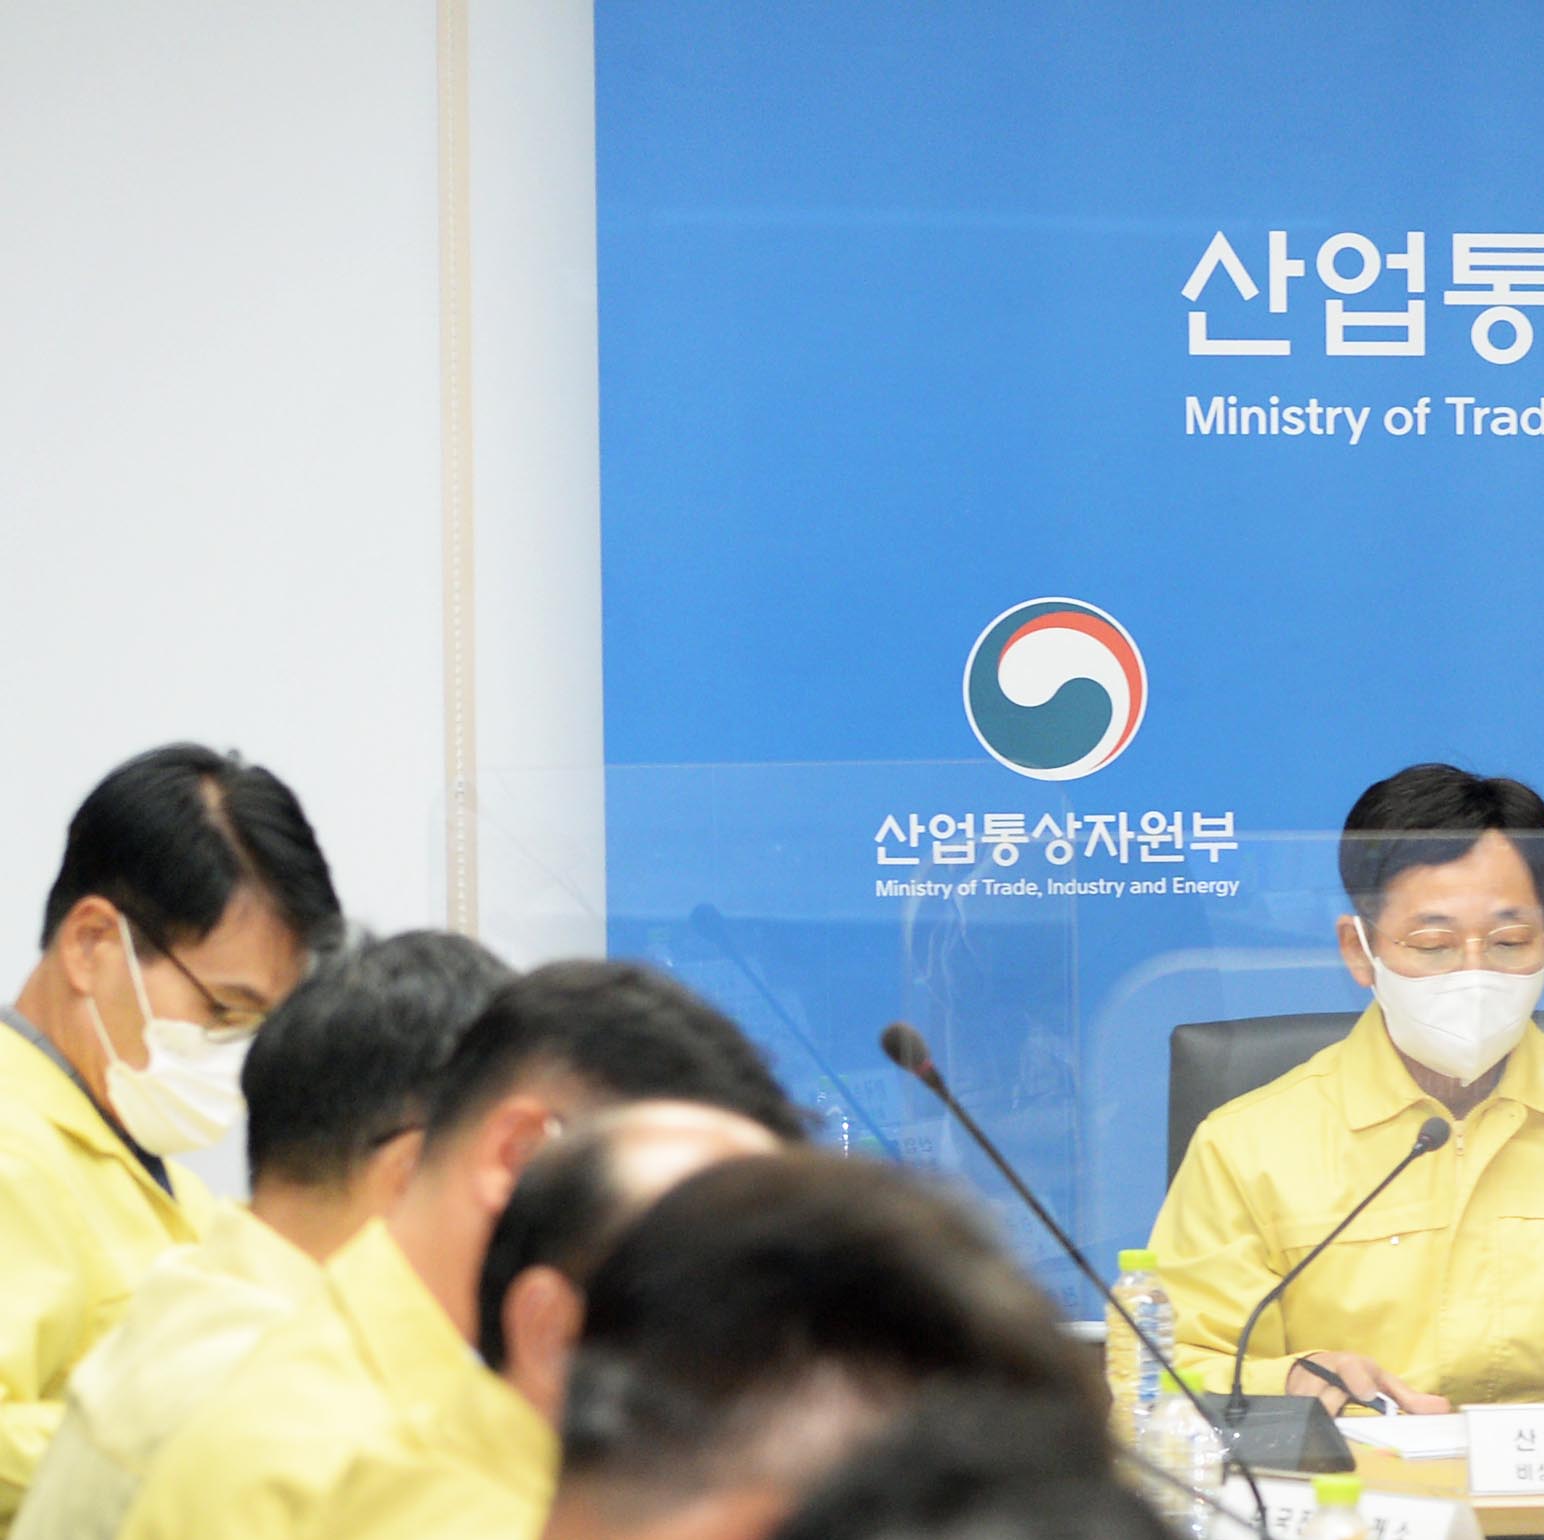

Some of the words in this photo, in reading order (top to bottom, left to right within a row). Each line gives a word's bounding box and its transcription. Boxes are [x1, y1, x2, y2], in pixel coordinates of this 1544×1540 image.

[1186, 395, 1371, 445] Ministry
[1384, 396, 1431, 437] of
[874, 811, 1238, 867] 산업통상자원부
[875, 878, 953, 900] Ministry
[956, 879, 978, 897] of
[981, 878, 1043, 898] Trade,
[1047, 877, 1125, 899] Industry
[1129, 876, 1167, 895] and
[1173, 876, 1240, 898] Energy
